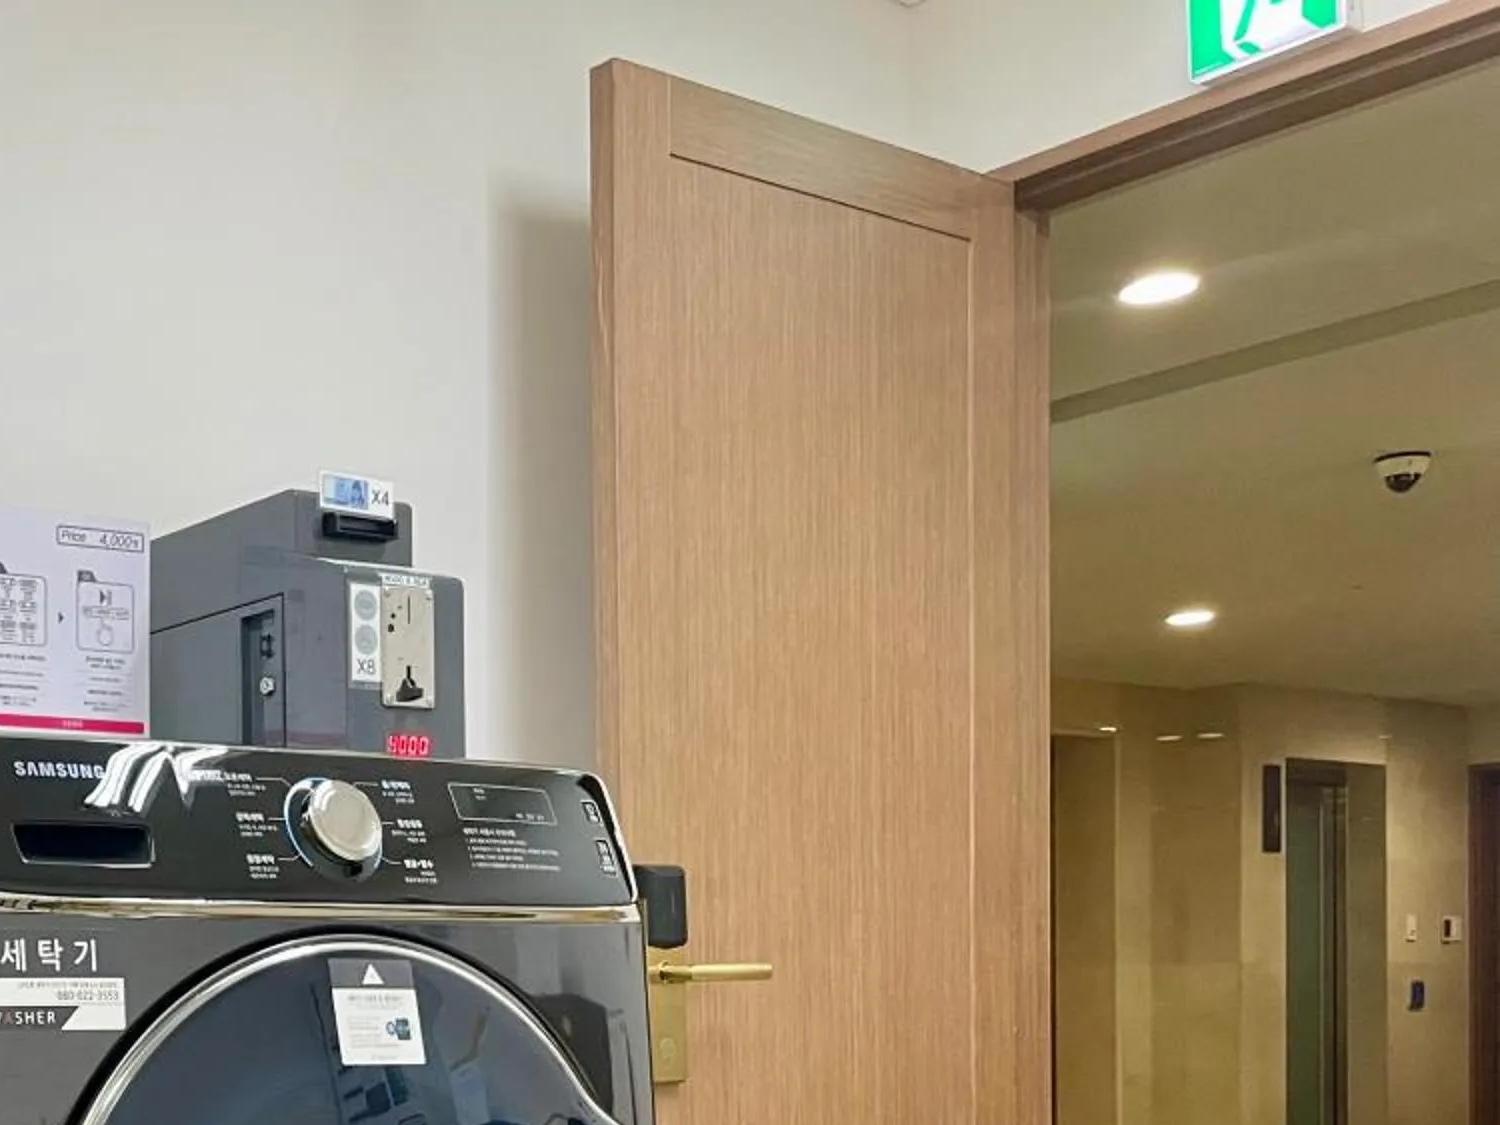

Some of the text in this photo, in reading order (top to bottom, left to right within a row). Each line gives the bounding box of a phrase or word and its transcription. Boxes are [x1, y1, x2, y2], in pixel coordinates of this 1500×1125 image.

[371, 488, 390, 506] X4
[356, 659, 377, 676] X8
[13, 760, 106, 780] SAMSUNG
[0, 937, 98, 973] 세탁기
